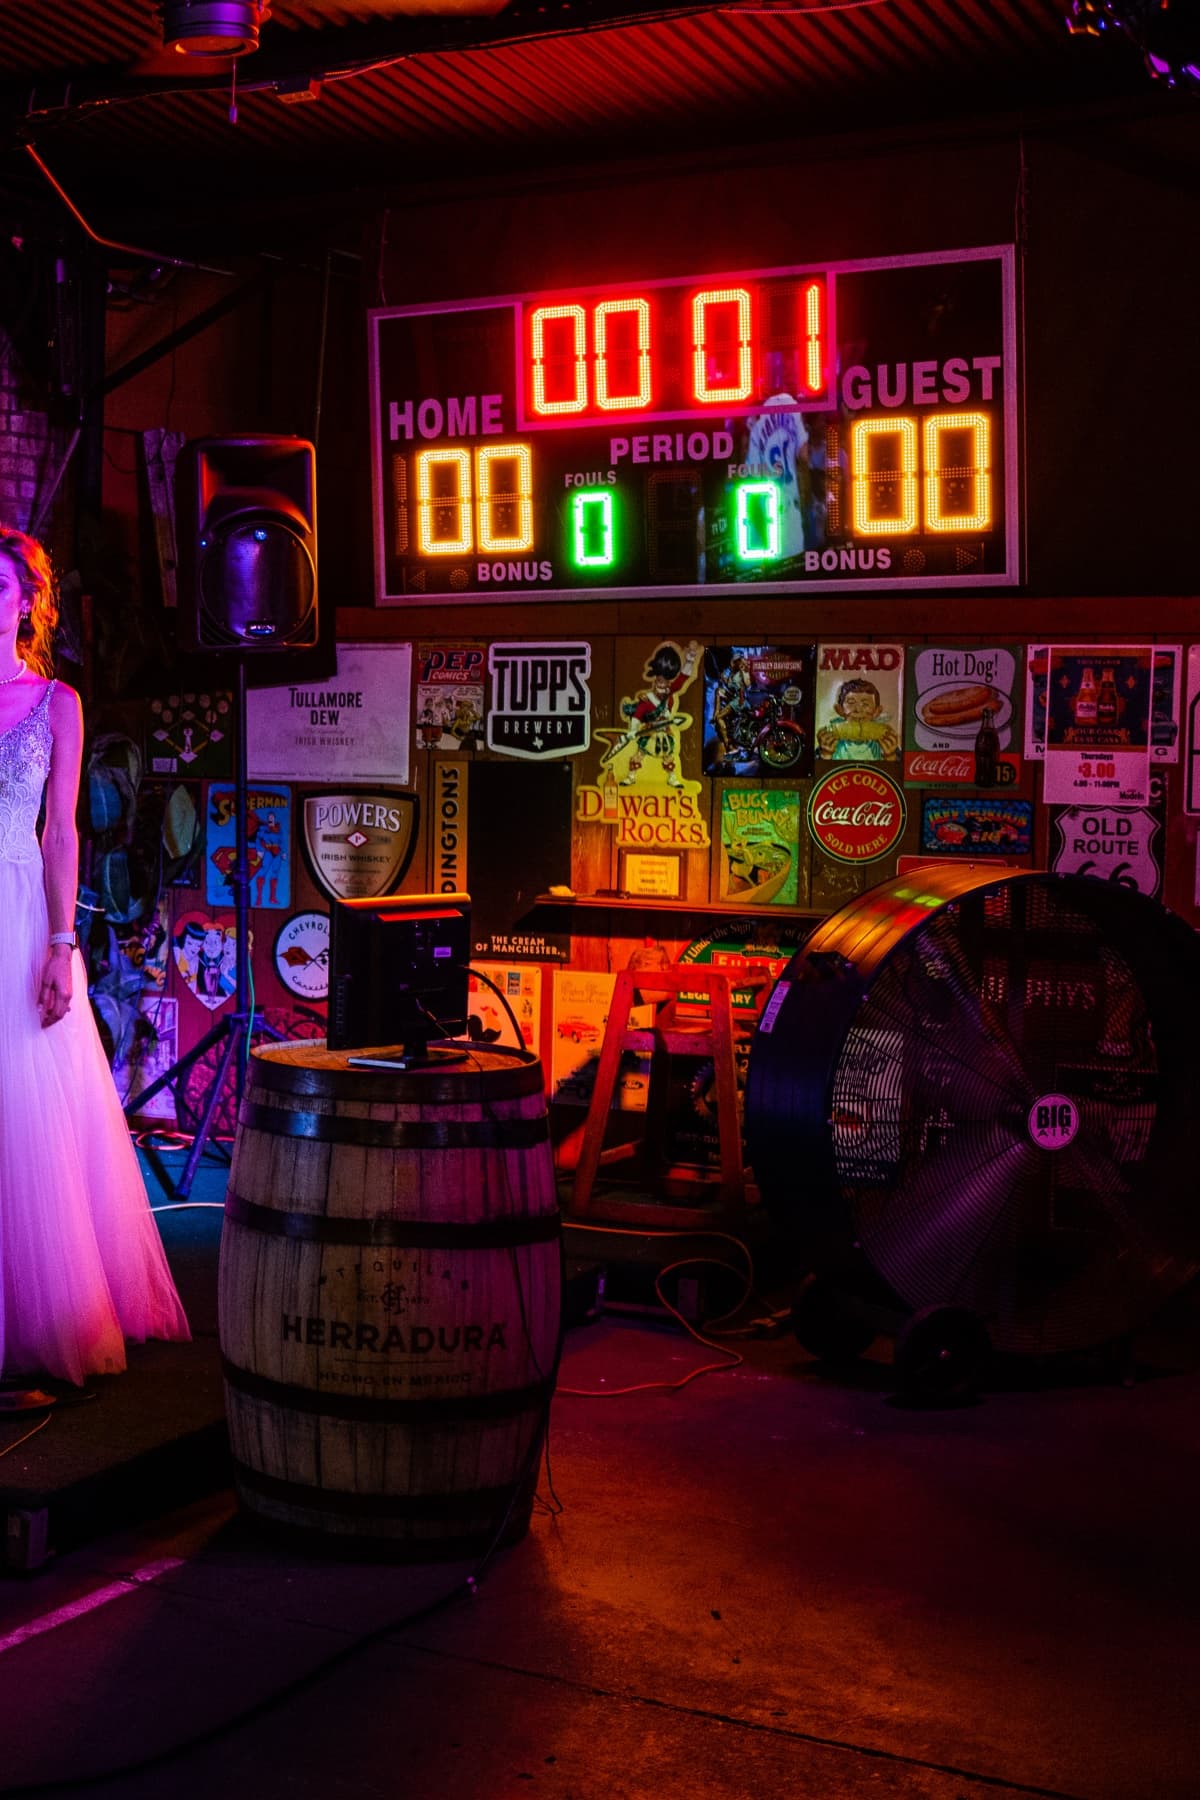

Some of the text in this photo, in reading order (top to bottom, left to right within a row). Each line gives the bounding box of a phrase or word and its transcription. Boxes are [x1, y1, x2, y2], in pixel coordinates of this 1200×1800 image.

[841, 355, 1002, 410] GUEST
[388, 394, 504, 441] HOME
[609, 431, 735, 465] PERIOD
[564, 470, 617, 488] FOULS
[727, 462, 784, 479] FOULS
[850, 411, 993, 536] 00
[415, 442, 535, 556] 00
[572, 490, 614, 567] 0
[734, 480, 782, 562] 0
[477, 560, 553, 583] BONUS
[804, 548, 892, 573] BONUS
[422, 650, 484, 682] PEP
[819, 648, 901, 672] MAD
[932, 653, 999, 682] Hot Dog!
[432, 671, 470, 681] COMICS
[493, 659, 587, 713] TUPPS
[288, 687, 363, 709] TULLAMORE
[310, 710, 340, 726] DEW
[504, 720, 573, 734] BREWERY
[320, 737, 355, 746] WHISKEY
[827, 773, 888, 796] ICE COLD
[210, 795, 289, 827] SUERMAN
[579, 789, 694, 819] Dwar's
[728, 791, 769, 810] BUGS
[315, 802, 402, 833] POWERS
[736, 808, 789, 827] BUNNY
[815, 799, 896, 827] Coca-Cola
[1082, 817, 1132, 836] OLD
[825, 832, 888, 855] SOLD HERE
[1073, 839, 1139, 856] ROUTE
[321, 853, 392, 864] IRISH WHISKEY
[288, 921, 329, 941] CHEVROL
[491, 935, 545, 946] THE CREAM
[476, 943, 561, 955] OF MANCHESTER.
[1037, 1105, 1071, 1128] BIG
[1036, 1128, 1071, 1137] AIR
[335, 1260, 451, 1281] TEQUILA
[282, 1314, 507, 1354] HERRADURA
[319, 1371, 374, 1386] HECHO
[383, 1375, 402, 1386] EN
